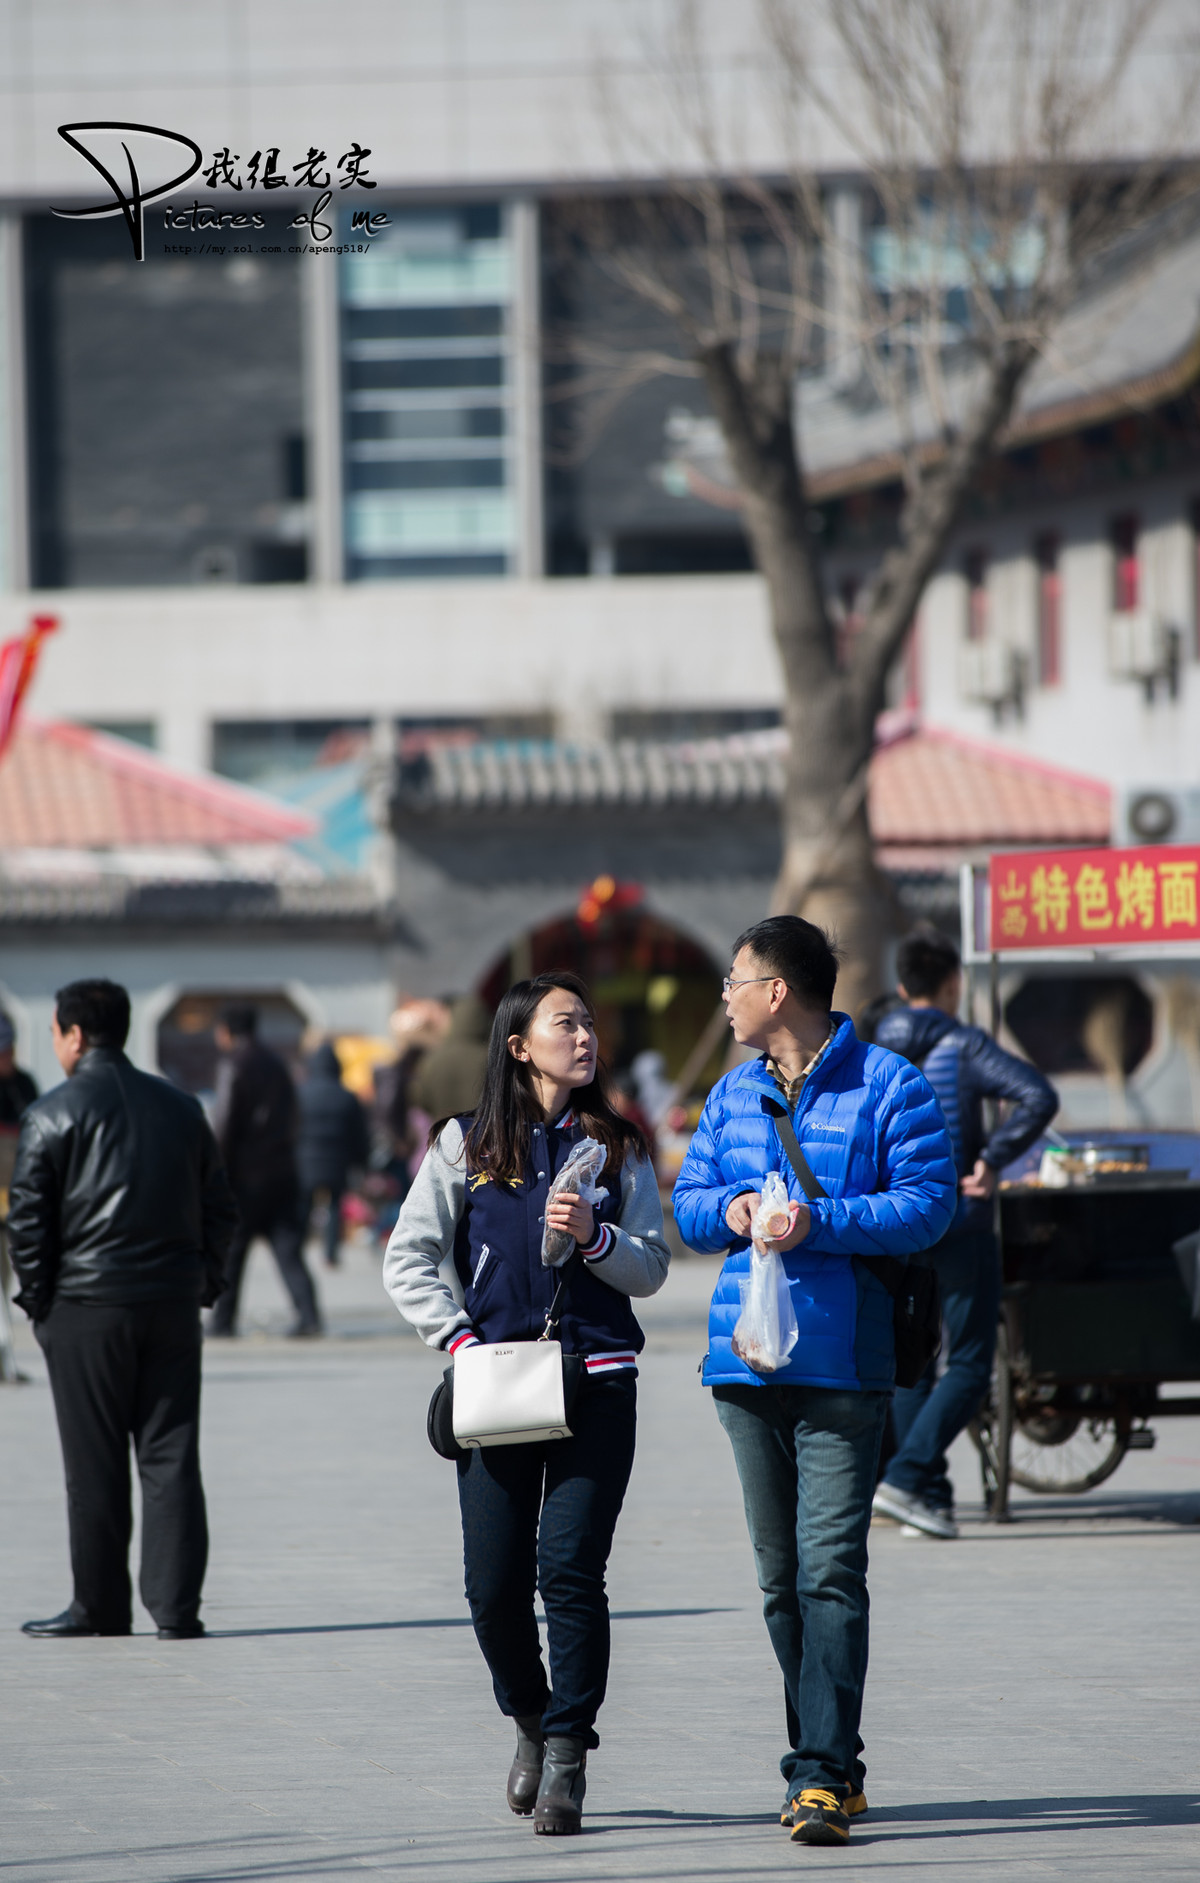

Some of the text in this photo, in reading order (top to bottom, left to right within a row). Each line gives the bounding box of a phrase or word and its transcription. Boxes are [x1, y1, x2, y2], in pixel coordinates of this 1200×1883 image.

[1031, 860, 1199, 933] 特色烤面
[816, 1122, 846, 1133] Columbia
